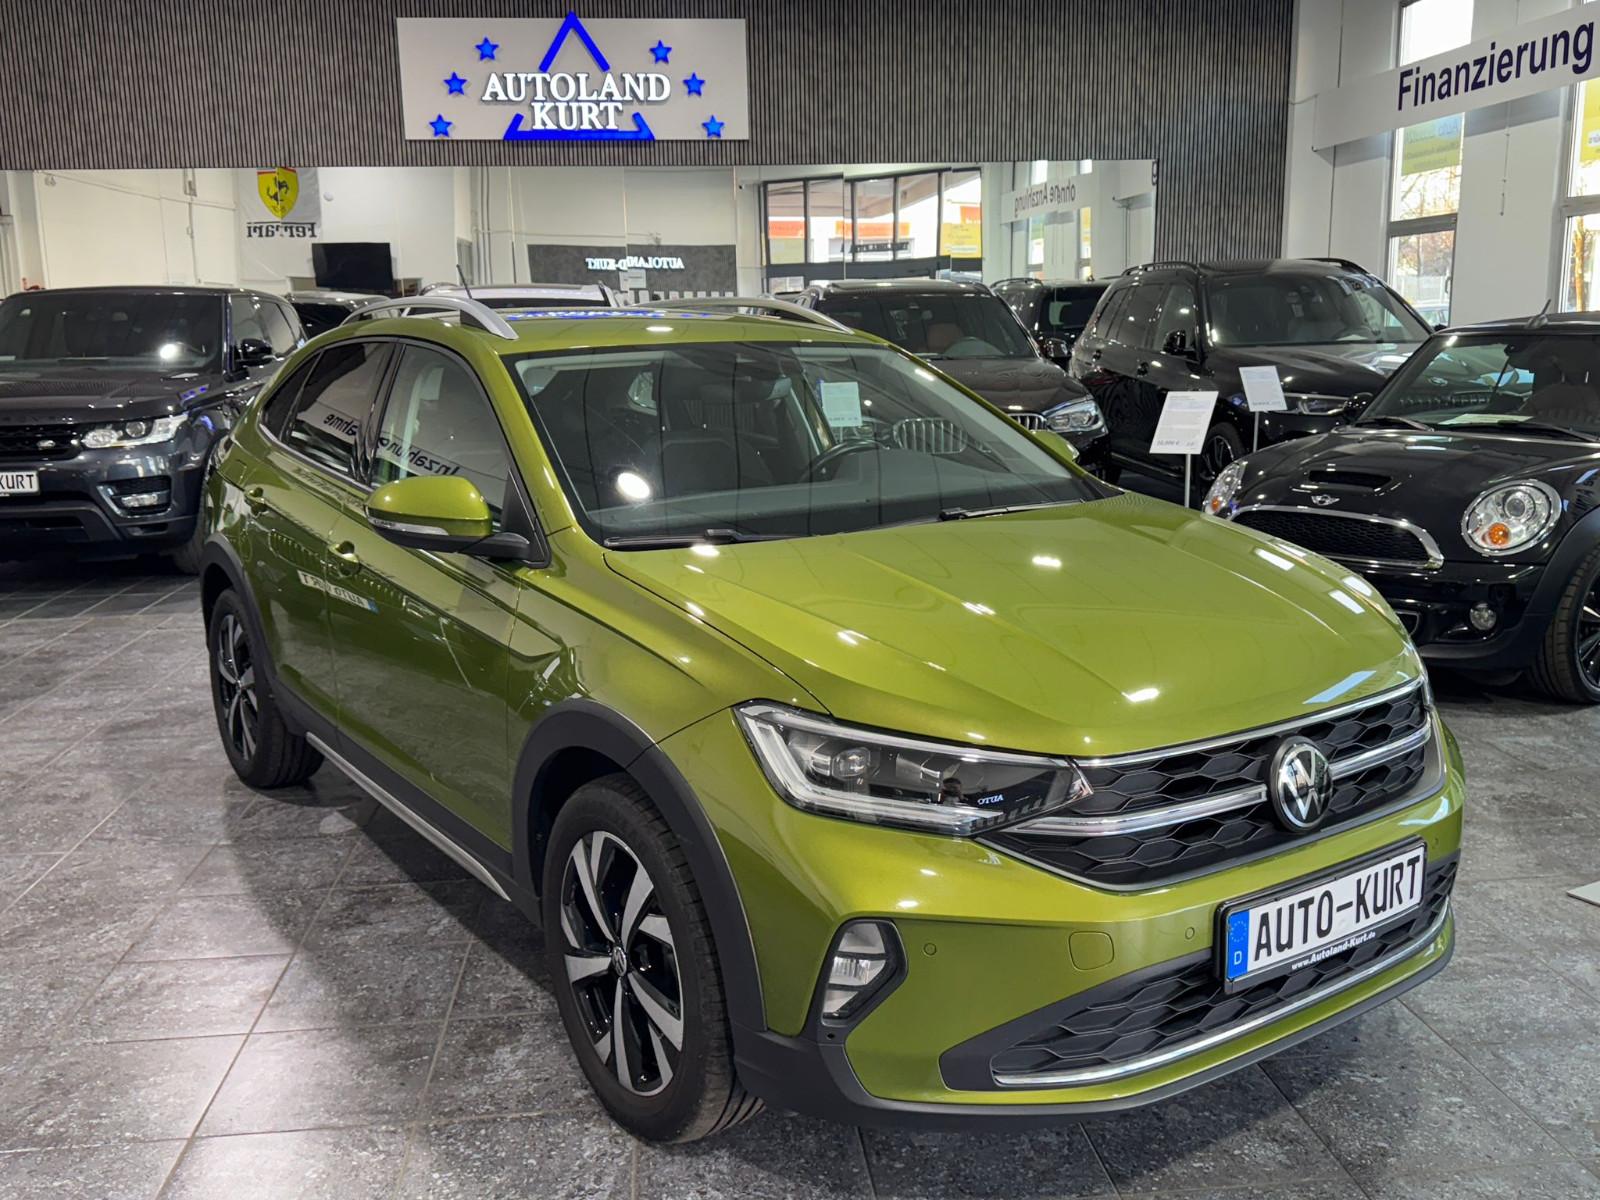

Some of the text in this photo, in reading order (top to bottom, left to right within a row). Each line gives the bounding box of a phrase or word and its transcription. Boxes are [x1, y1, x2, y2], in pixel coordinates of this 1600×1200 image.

[482, 73, 671, 101] AUTOLAND
[1398, 22, 1595, 111] Finanzierung
[530, 102, 623, 130] KURT
[1233, 855, 1420, 966] D AUTO-KURT
[1291, 930, 1377, 971] www.Autoland-Kurt.de
